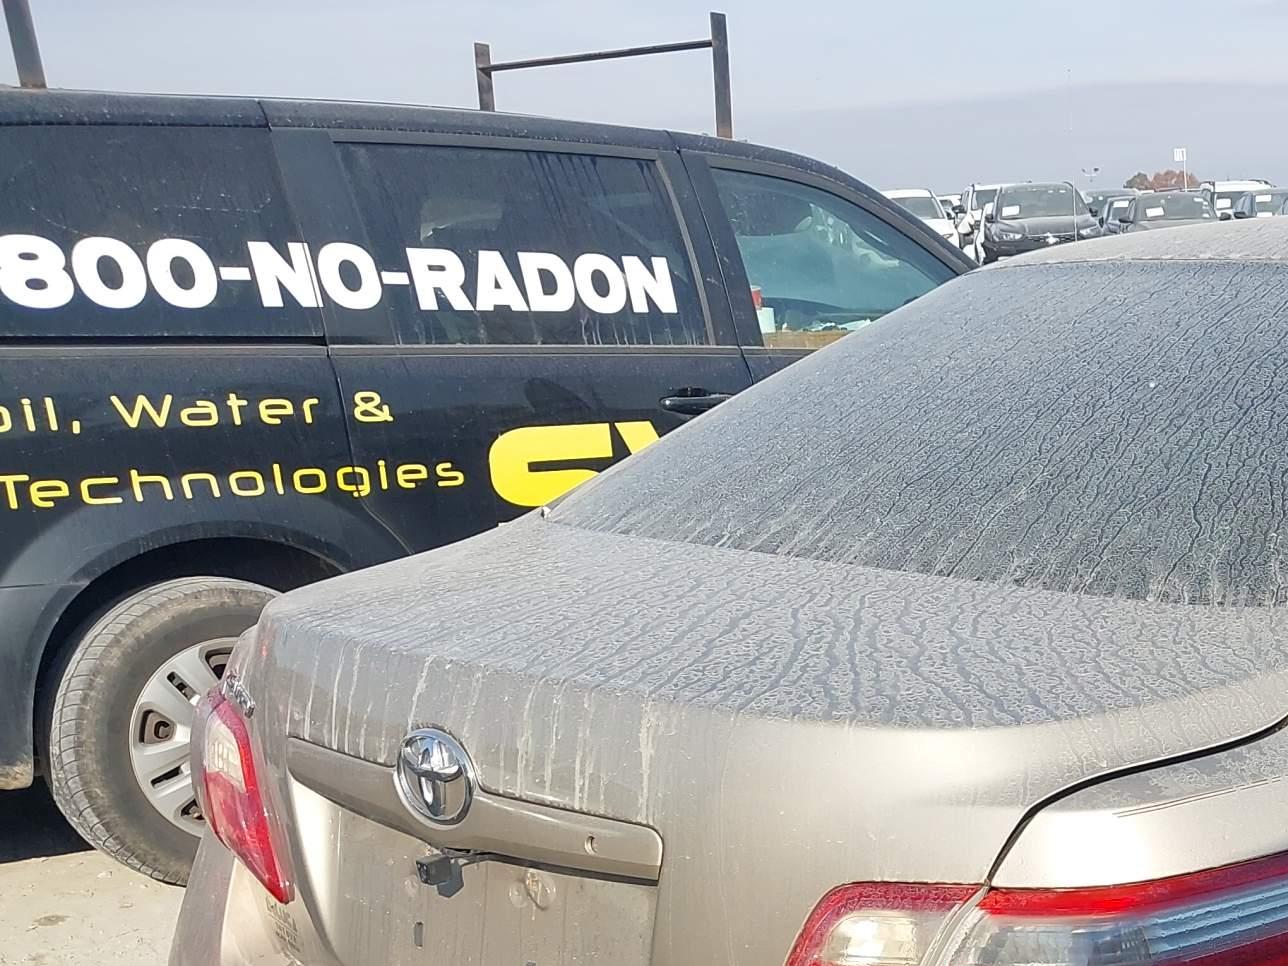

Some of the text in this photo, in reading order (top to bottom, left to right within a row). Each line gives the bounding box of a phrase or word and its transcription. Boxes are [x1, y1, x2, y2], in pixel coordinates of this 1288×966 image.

[110, 393, 319, 428] Water
[353, 391, 394, 422] &
[0, 460, 465, 509] Technologies
